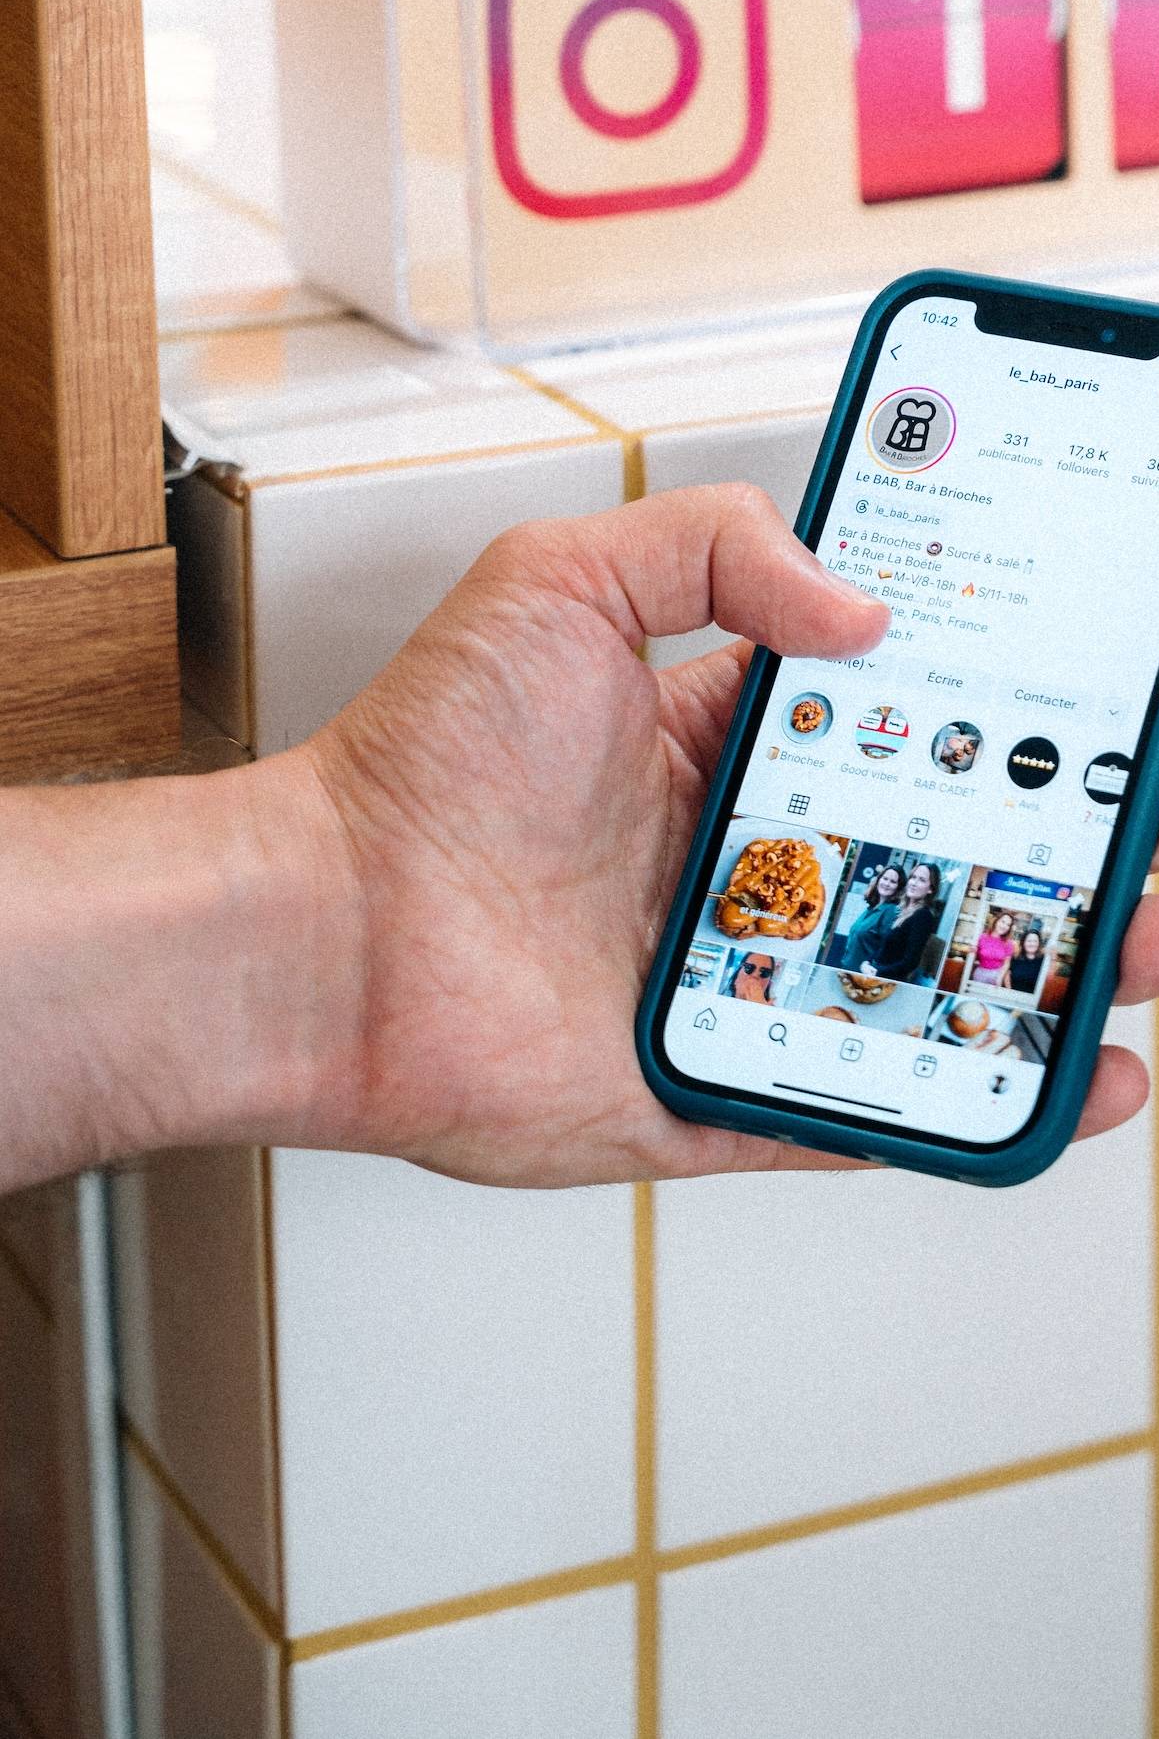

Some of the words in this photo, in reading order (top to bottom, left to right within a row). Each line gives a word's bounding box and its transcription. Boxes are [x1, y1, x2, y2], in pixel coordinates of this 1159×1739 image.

[921, 312, 958, 328] 10:42
[1009, 366, 1100, 393] le_bab_paris
[1003, 433, 1029, 447] 331
[978, 447, 1043, 466] publications
[1068, 444, 1095, 460] 17,8
[1098, 450, 1109, 462] K
[1056, 460, 1110, 479] followers
[856, 471, 870, 482] Le
[873, 474, 900, 489] BAB,
[905, 480, 927, 493] Bar
[929, 484, 936, 495] à
[939, 486, 993, 505] Brioches
[875, 505, 941, 526] le_bab_paris
[838, 526, 858, 539] Bar
[860, 530, 868, 541] à
[871, 532, 922, 551] Brioches
[850, 546, 859, 556] 8
[862, 548, 884, 561] Rue
[887, 553, 902, 564] La
[905, 556, 942, 572] Boétie
[946, 546, 981, 562] Sucré
[984, 553, 993, 564] &
[996, 557, 1020, 569] salé
[894, 571, 956, 592] M-V/8-18h
[860, 582, 878, 595] rue
[927, 595, 953, 609] plus
[977, 587, 1028, 605] S/11-18h
[911, 609, 943, 626] Paris,
[947, 616, 988, 633] France
[927, 670, 963, 688] Écrire
[1014, 689, 1077, 709] Contacter
[780, 751, 825, 768] Brioches
[841, 763, 868, 777] Good
[871, 768, 898, 783] vibes
[914, 777, 936, 790] BAB
[939, 781, 977, 799] CADET
